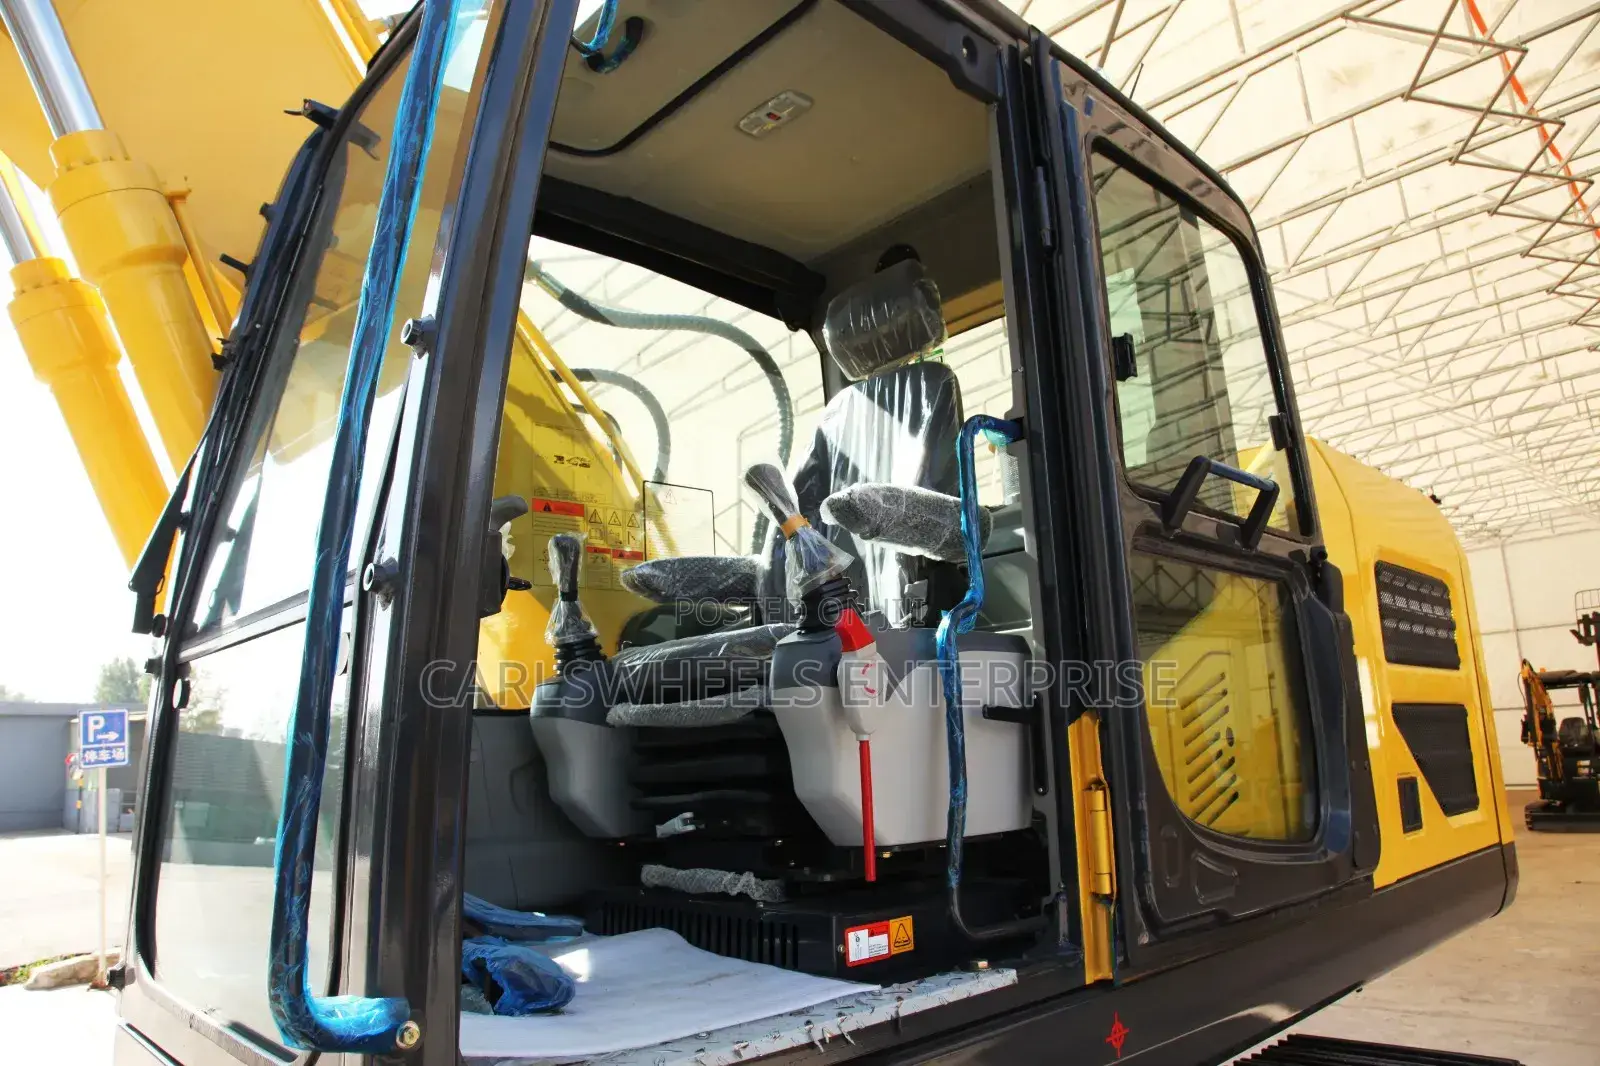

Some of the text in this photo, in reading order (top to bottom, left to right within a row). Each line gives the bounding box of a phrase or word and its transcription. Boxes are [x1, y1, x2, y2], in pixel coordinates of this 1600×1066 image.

[88, 715, 105, 742] P
[84, 748, 125, 762] 停车场
